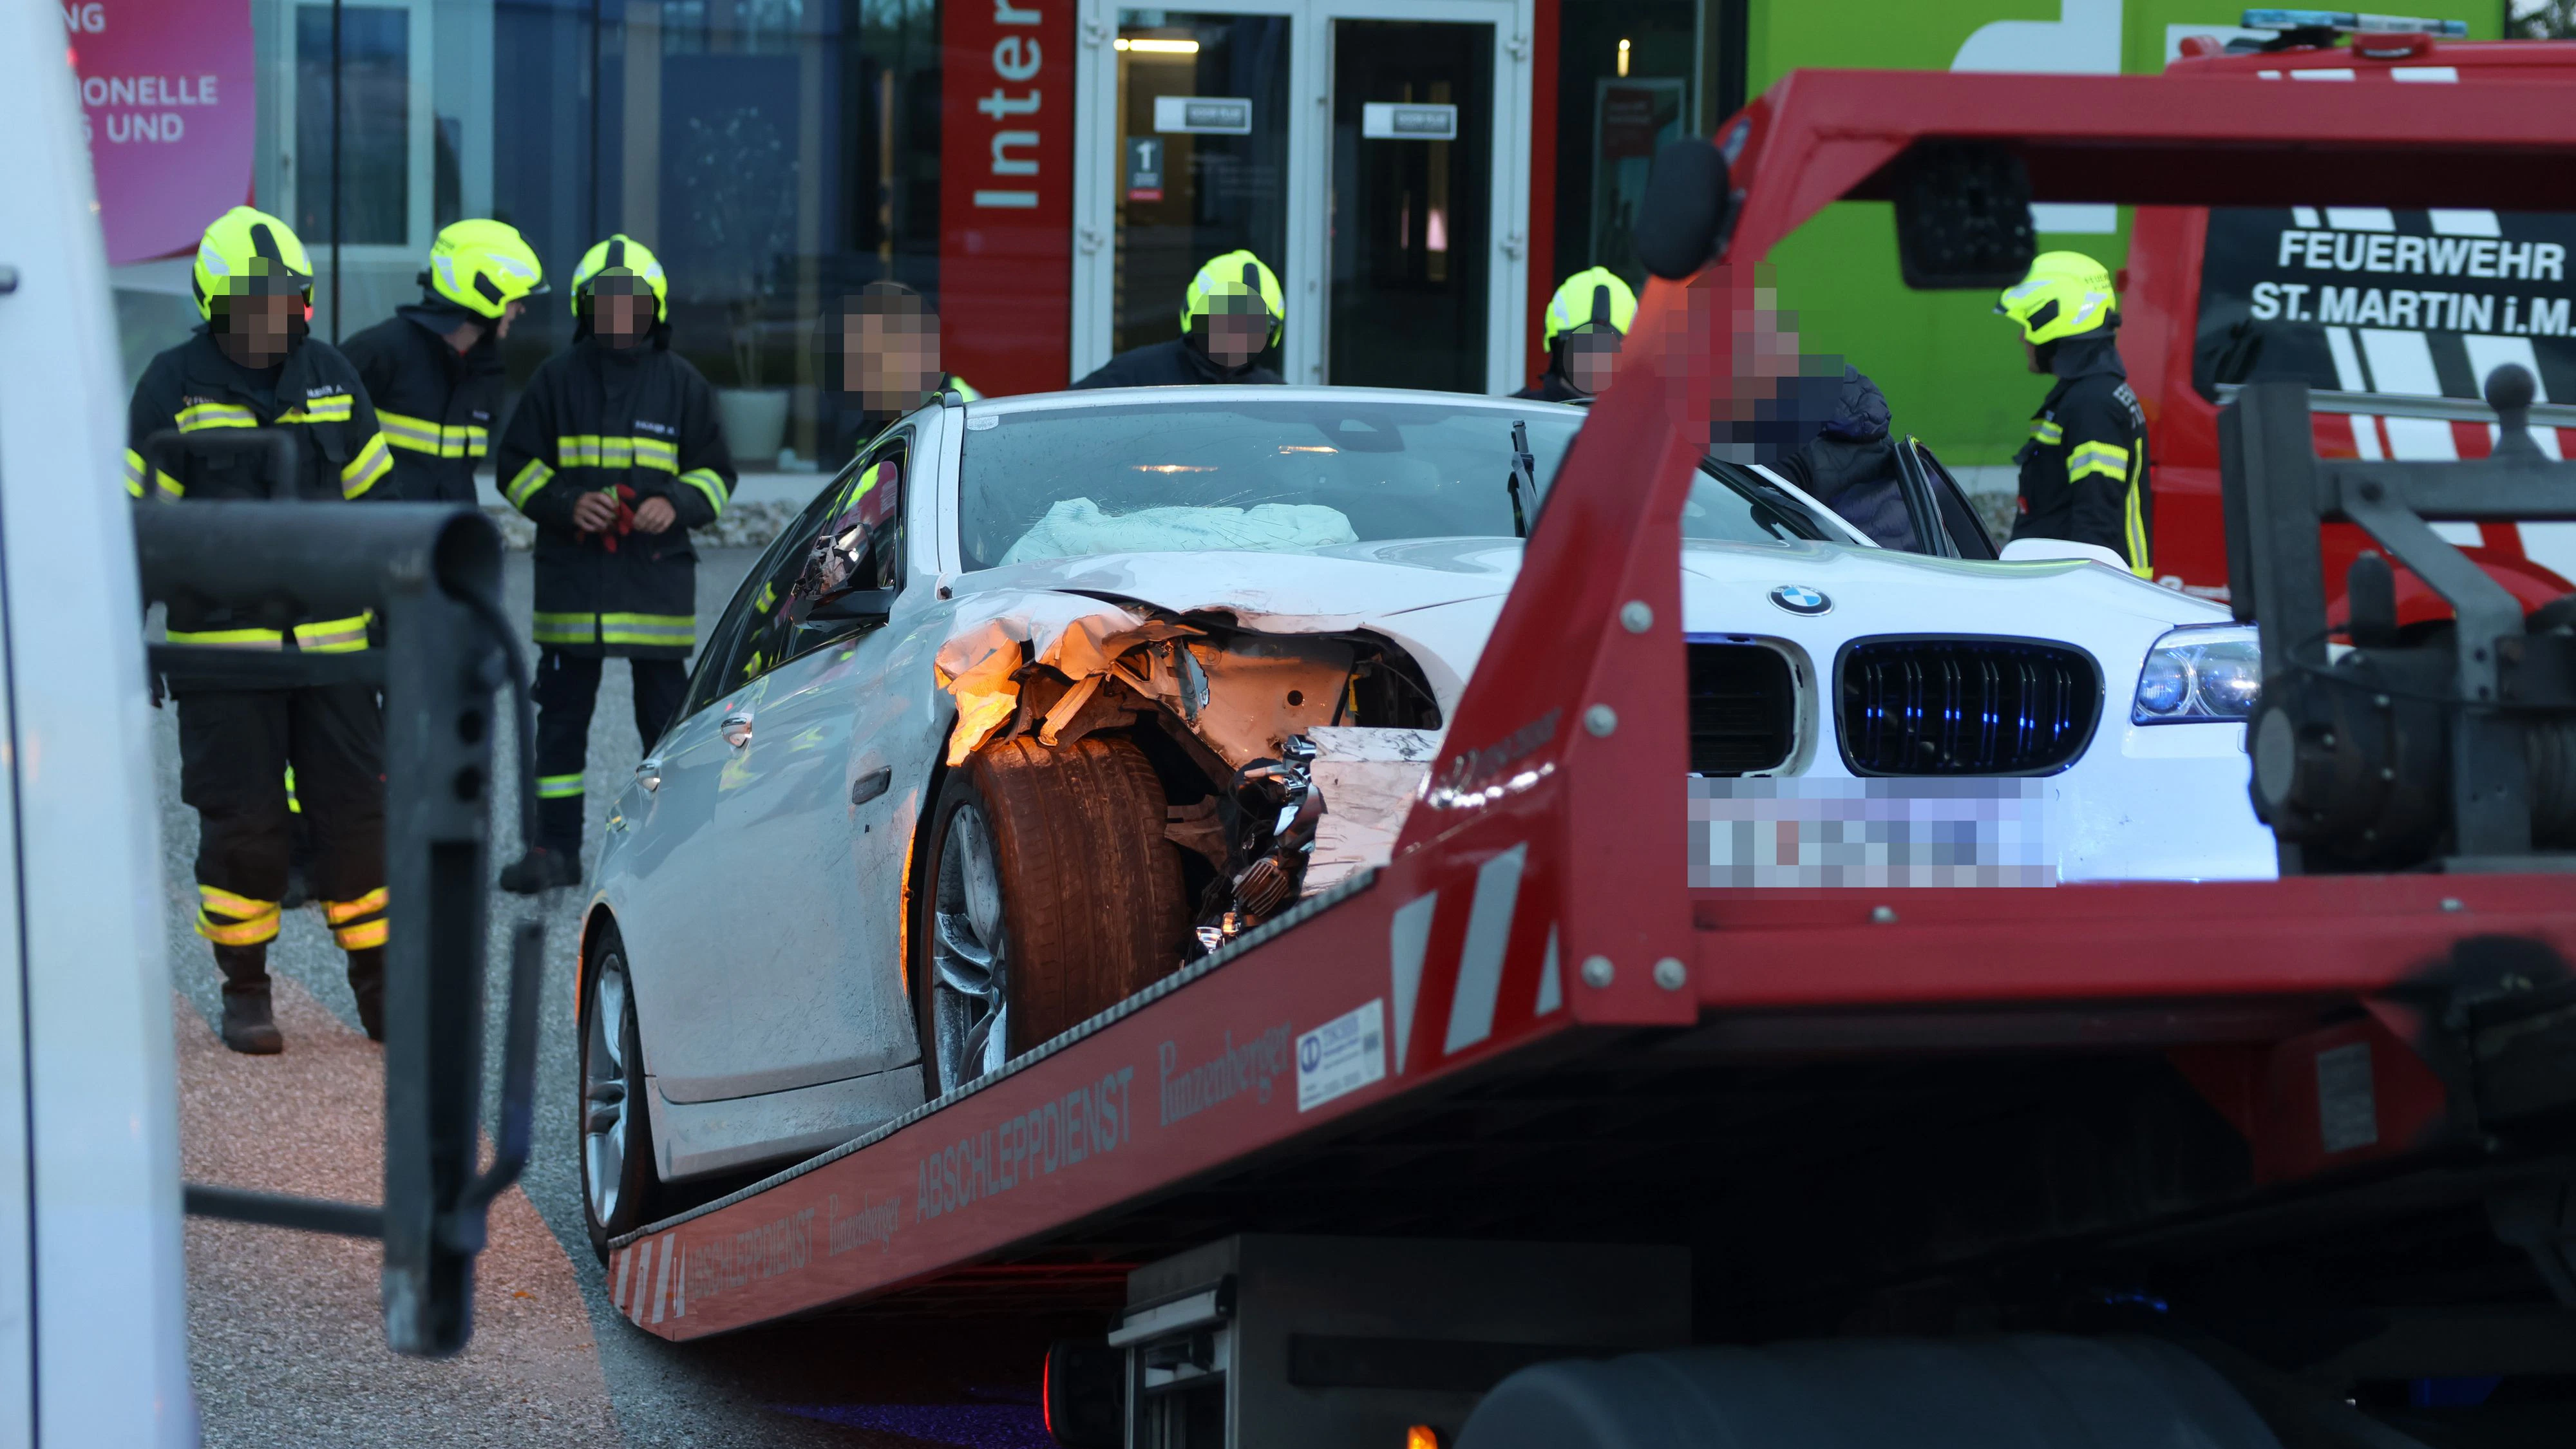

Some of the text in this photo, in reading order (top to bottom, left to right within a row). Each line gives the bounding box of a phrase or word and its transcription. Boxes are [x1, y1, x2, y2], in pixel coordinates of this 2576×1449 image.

[106, 113, 185, 143] UND
[2278, 230, 2566, 281] FEUERWEHR
[2251, 281, 2312, 321] ST.
[2318, 285, 2495, 332] MARTIN
[916, 1065, 1133, 1223] ABSCHLEPPDIENST
